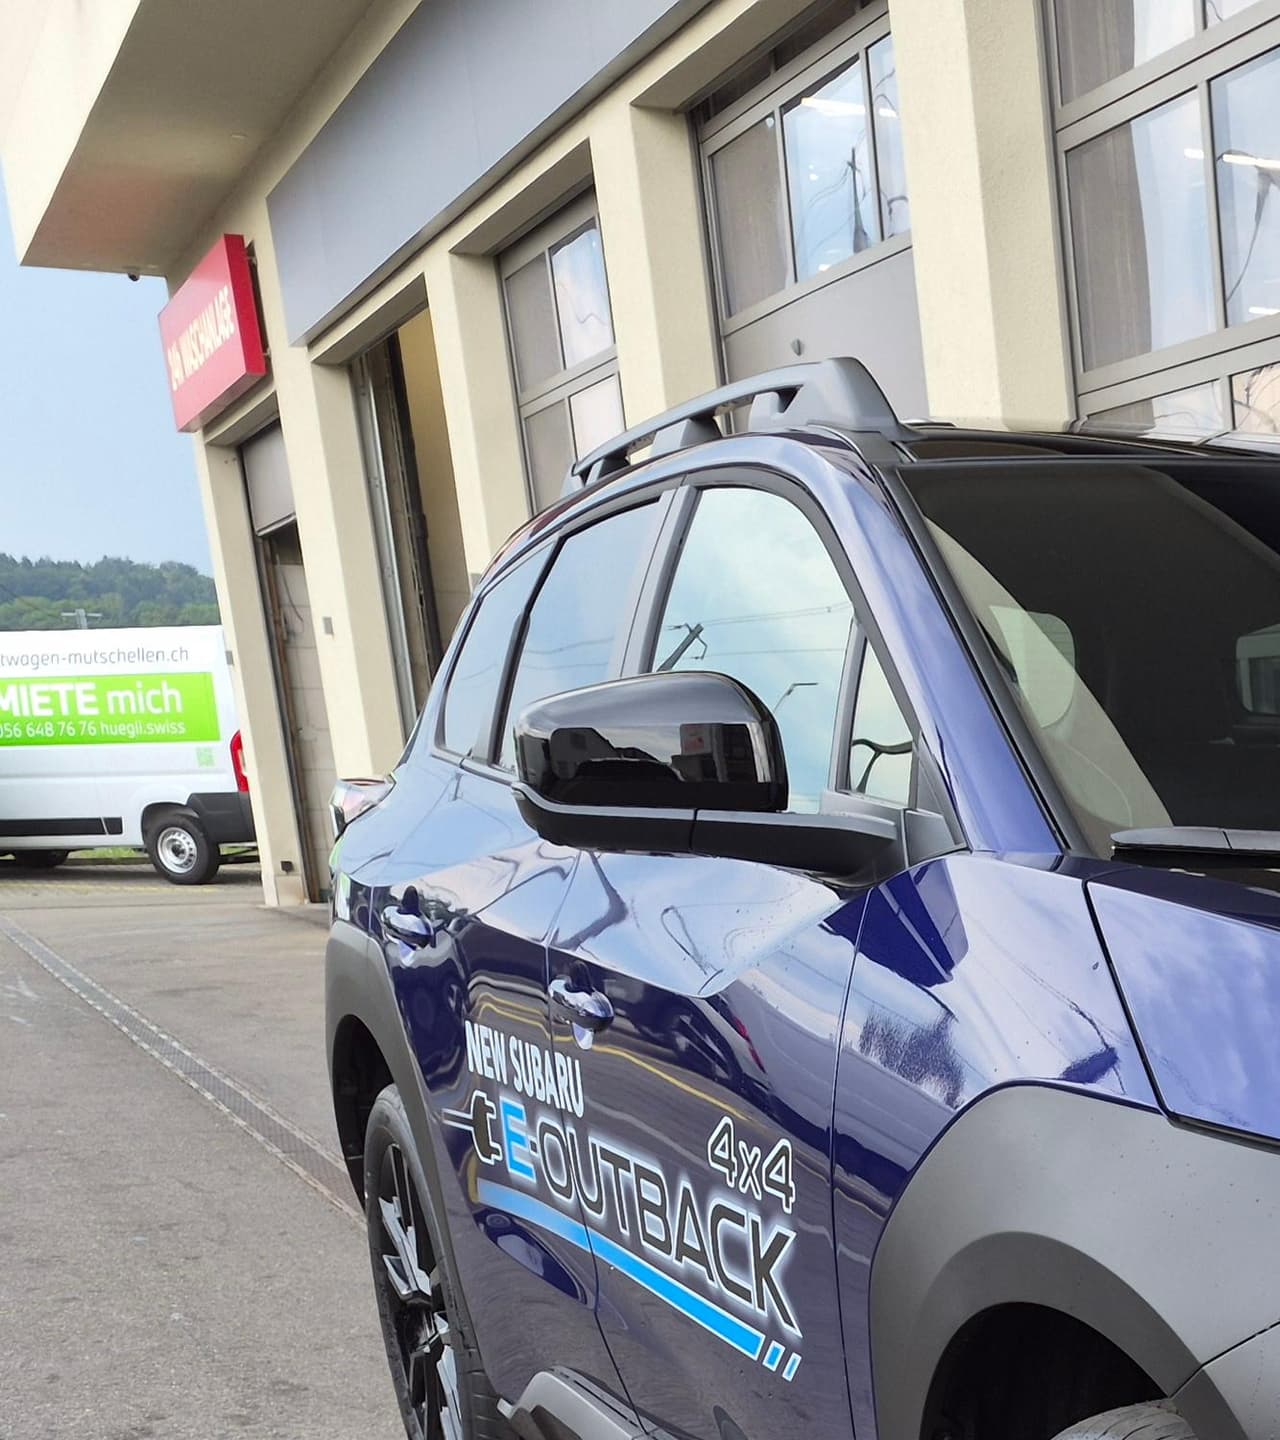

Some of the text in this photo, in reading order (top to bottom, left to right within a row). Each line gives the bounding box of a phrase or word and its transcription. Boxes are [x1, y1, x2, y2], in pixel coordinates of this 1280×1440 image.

[26, 722, 55, 737] 648
[57, 721, 75, 736] 76
[78, 720, 97, 736] 76
[100, 719, 186, 739] huegli.swiss
[106, 680, 183, 714] mich
[464, 1020, 584, 1118] NEW SUBARU
[707, 1116, 796, 1215] 4x4
